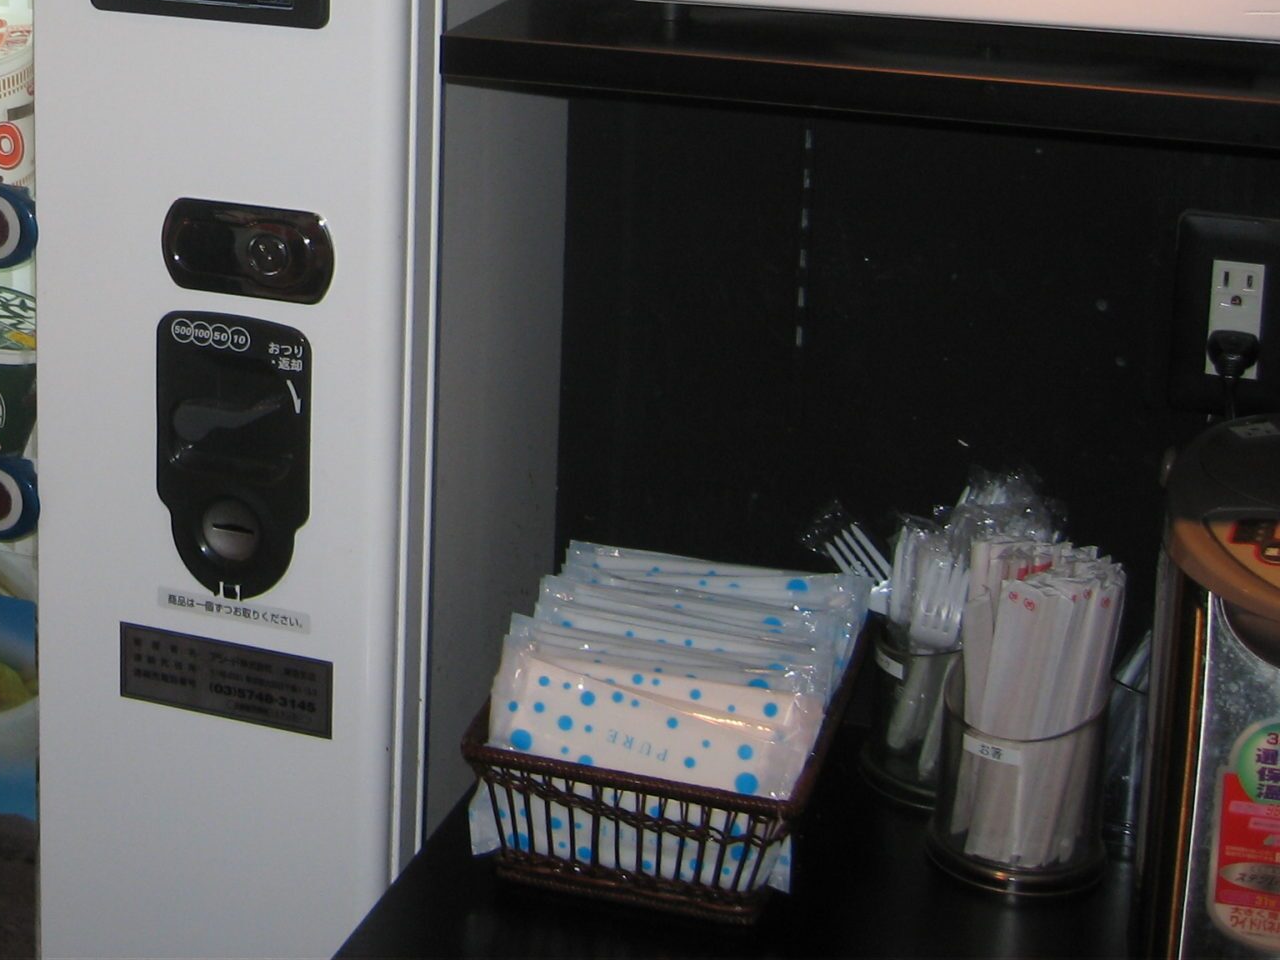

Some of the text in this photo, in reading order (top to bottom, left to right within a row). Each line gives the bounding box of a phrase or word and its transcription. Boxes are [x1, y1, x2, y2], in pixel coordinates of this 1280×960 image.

[174, 325, 246, 344] 500 100 50 10
[268, 342, 303, 358] おつり
[168, 594, 303, 628] 商品は一個ずつお取りください。
[607, 729, 668, 761] PURE
